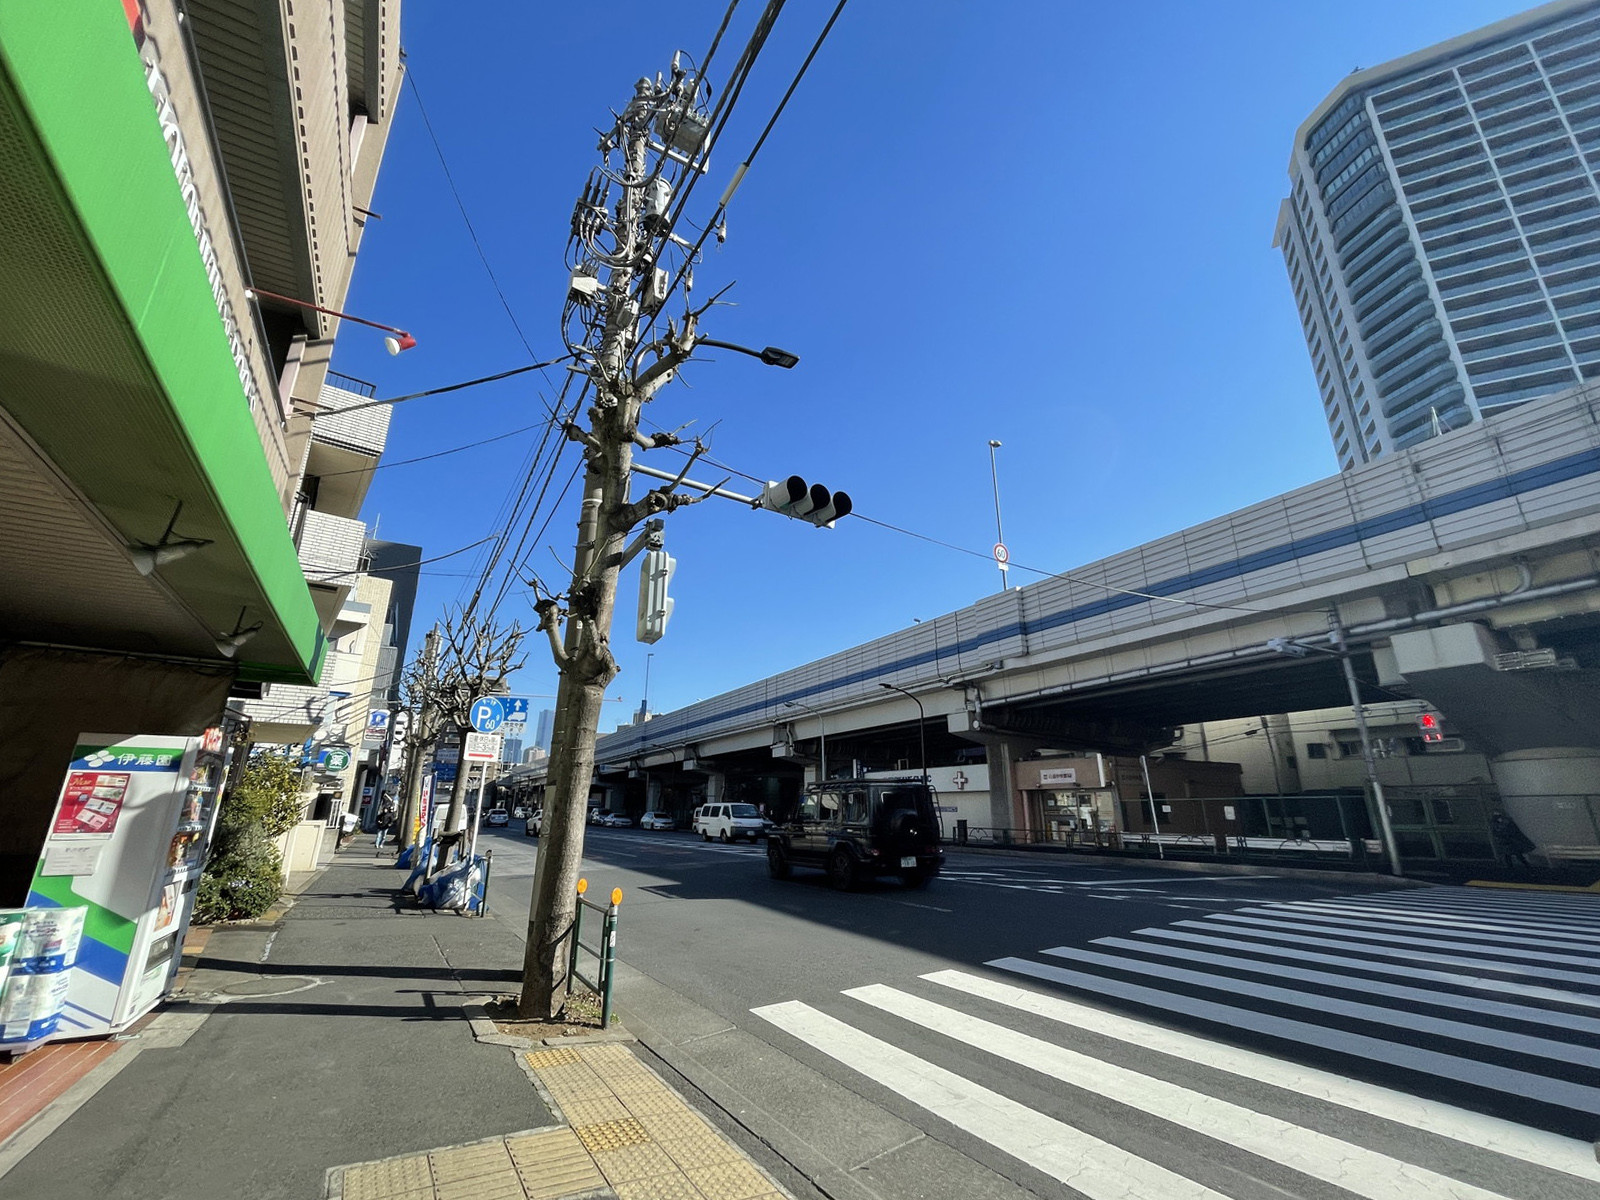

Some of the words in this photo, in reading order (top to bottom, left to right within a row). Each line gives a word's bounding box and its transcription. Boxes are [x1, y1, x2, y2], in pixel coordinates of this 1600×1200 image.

[997, 548, 1005, 558] 60
[476, 706, 491, 728] P
[485, 719, 495, 730] 60
[117, 753, 173, 766] 伊藤園
